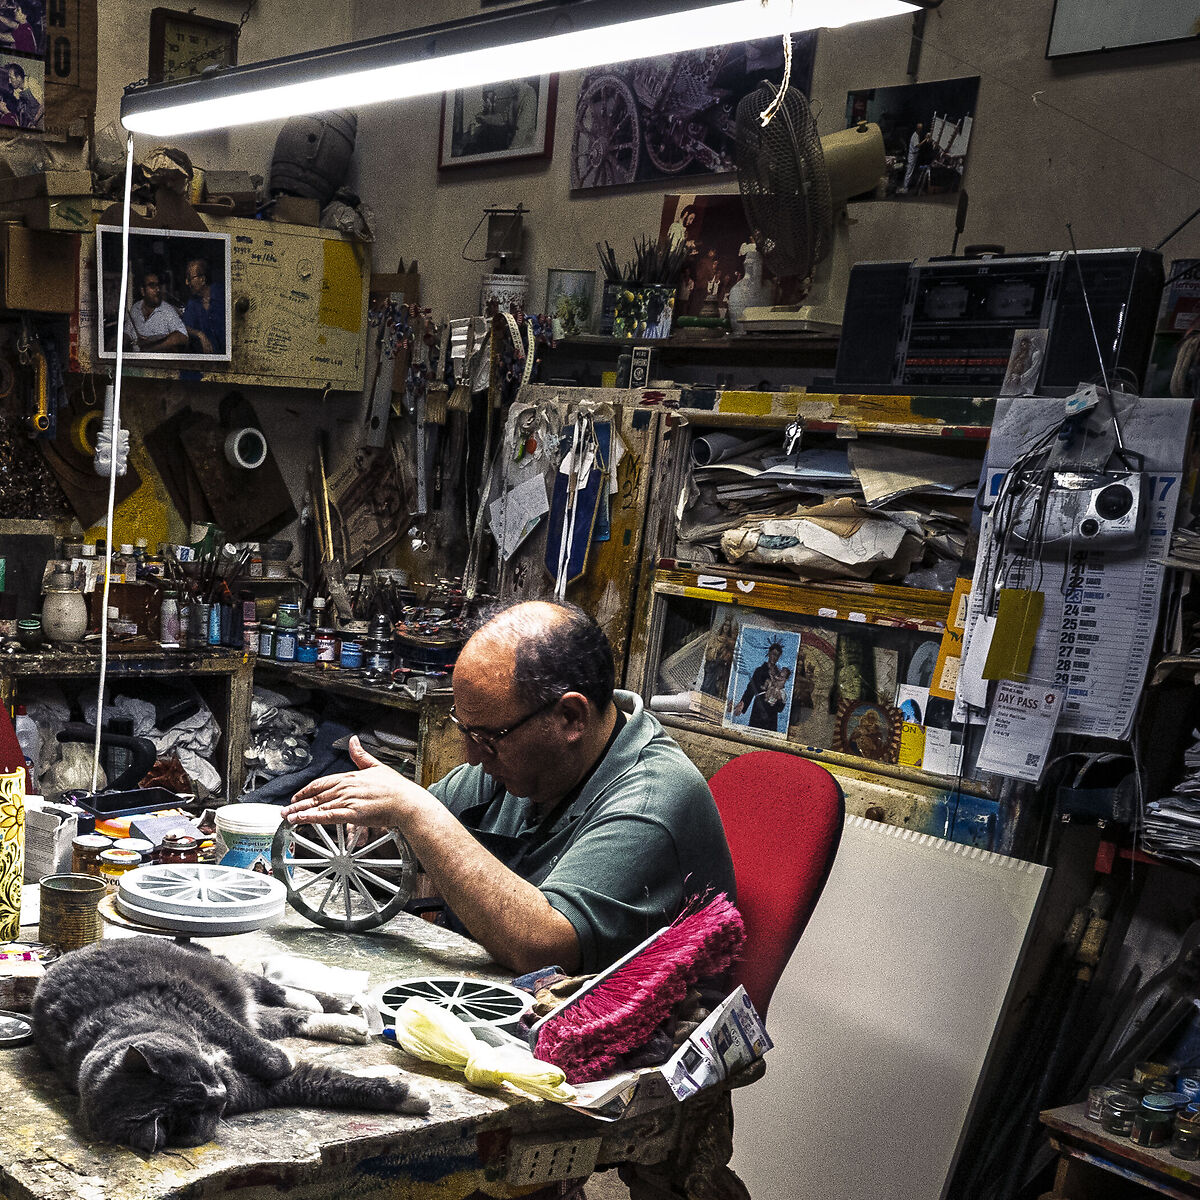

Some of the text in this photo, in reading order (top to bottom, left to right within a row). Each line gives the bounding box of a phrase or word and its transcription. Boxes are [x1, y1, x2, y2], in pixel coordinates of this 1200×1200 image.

[1063, 604, 1080, 616] 24
[1062, 618, 1078, 630] 25
[1060, 631, 1076, 644] 26
[1058, 645, 1074, 658] 27
[1056, 659, 1072, 672] 28
[998, 692, 1016, 705] DAY
[1016, 696, 1039, 710] PASS
